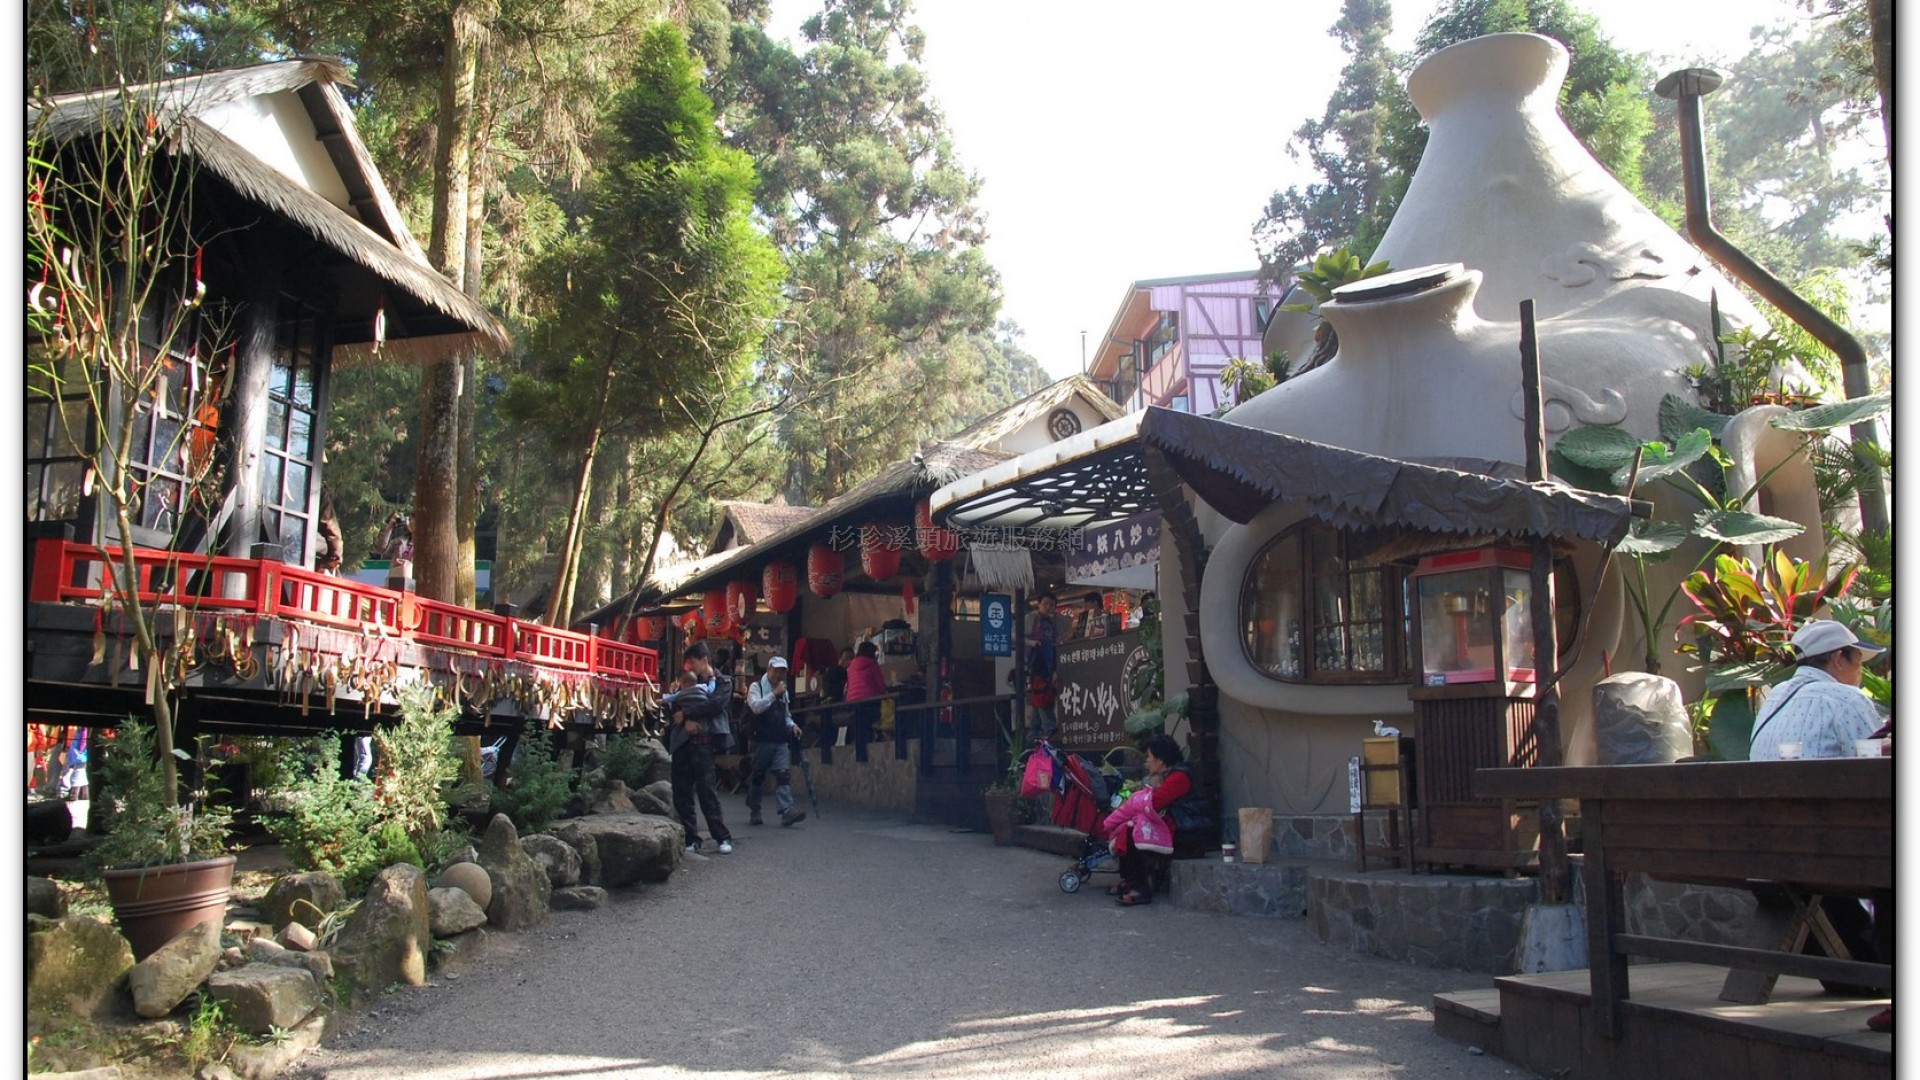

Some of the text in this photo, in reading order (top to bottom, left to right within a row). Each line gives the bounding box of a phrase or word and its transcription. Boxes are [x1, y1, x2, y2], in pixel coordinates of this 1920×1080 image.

[1097, 523, 1143, 555] 妖八炒
[1059, 682, 1120, 726] 妖八炒
